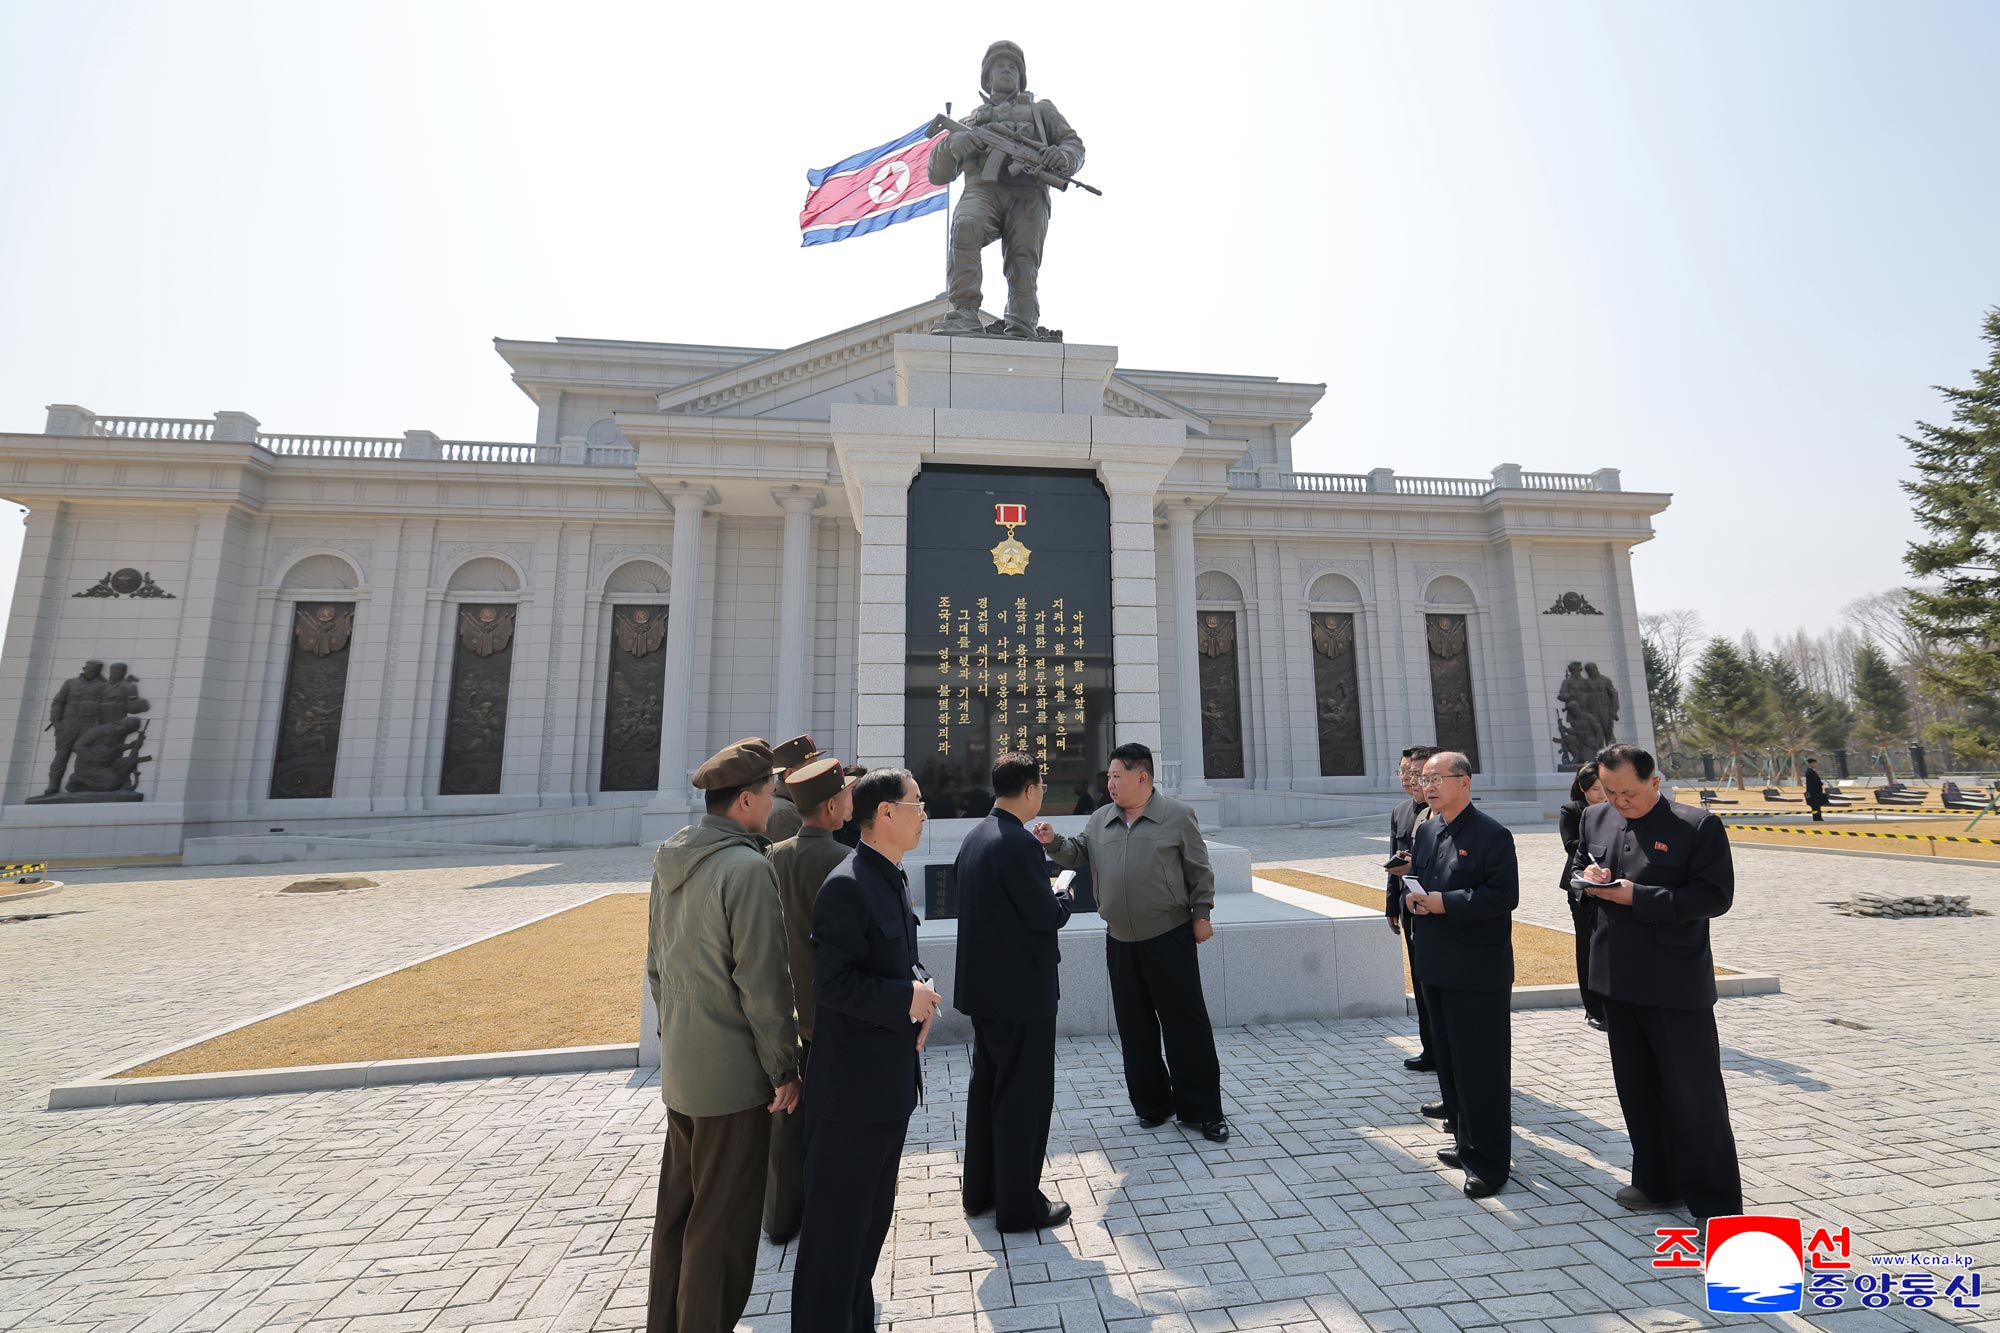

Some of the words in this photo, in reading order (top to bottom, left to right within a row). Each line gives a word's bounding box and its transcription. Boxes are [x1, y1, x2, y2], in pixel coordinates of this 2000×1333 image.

[938, 596, 952, 635] 조국의
[957, 609, 971, 649] 그대들
[976, 597, 989, 636] 경건히
[997, 610, 1008, 624] 이
[1014, 597, 1028, 636] 불굴의
[1034, 610, 1047, 649] 가렬한
[1052, 598, 1066, 636] 지켜야
[938, 647, 951, 674] 영광
[997, 636, 1010, 664] 나라
[1054, 643, 1066, 656] 할
[1073, 660, 1085, 673] 할
[976, 644, 990, 697] 새기나니
[1015, 643, 1029, 696] 용감성과
[957, 687, 971, 725] 기개로
[996, 672, 1010, 725] 영웅성의
[1016, 703, 1029, 714] 그
[1034, 657, 1048, 724] 전투포화를
[1072, 682, 1086, 724] 생앞에
[937, 684, 951, 755] 불멸하리라
[1055, 711, 1068, 751] 놓으며
